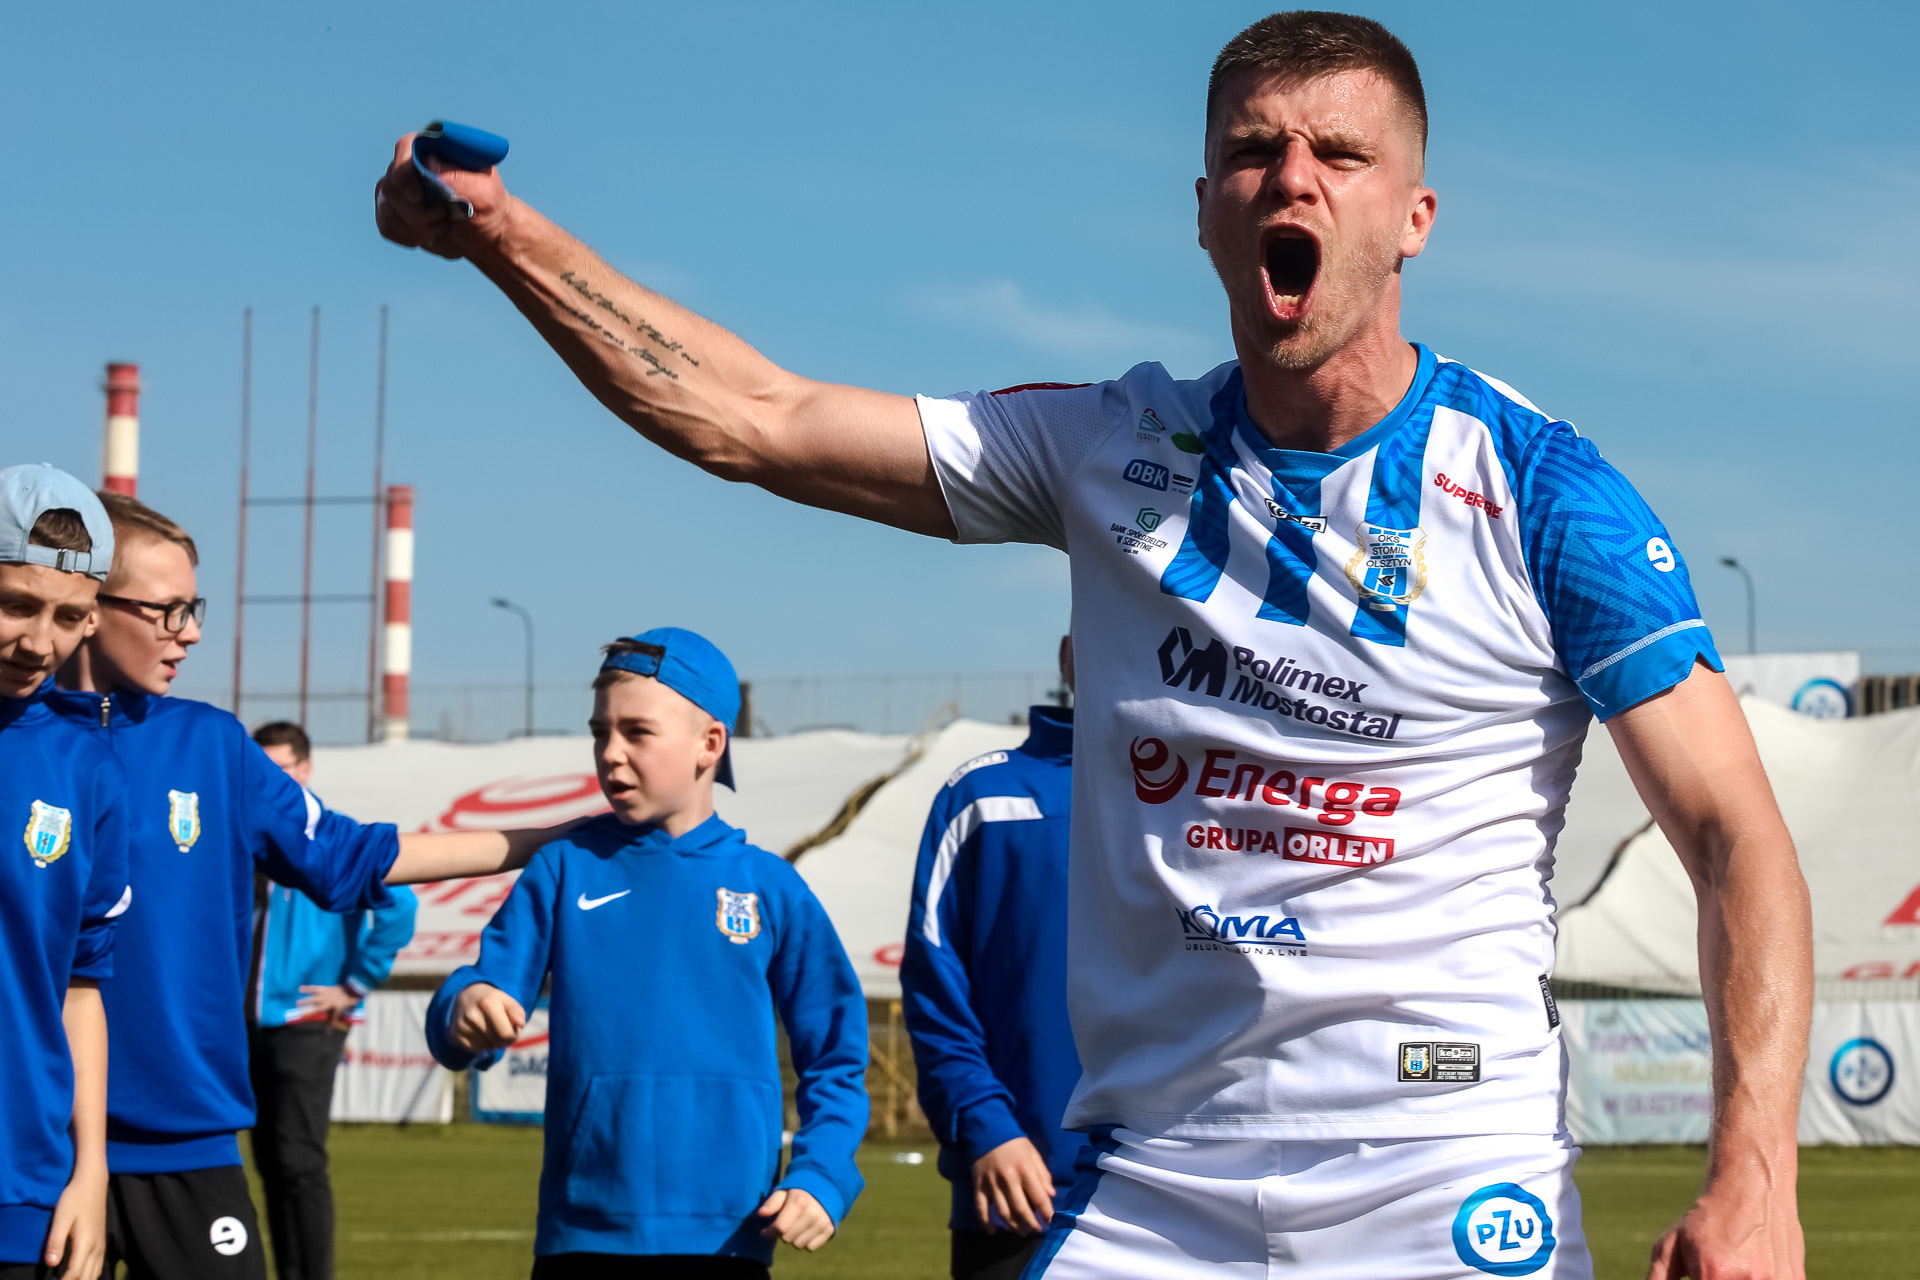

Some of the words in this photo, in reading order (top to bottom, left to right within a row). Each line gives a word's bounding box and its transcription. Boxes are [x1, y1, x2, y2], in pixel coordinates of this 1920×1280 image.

[1128, 462, 1166, 487] DBK
[1110, 522, 1128, 534] BANK
[1378, 534, 1400, 543] OKS
[1366, 558, 1412, 567] OLSZTYN
[1372, 546, 1406, 555] STOMIL
[1233, 645, 1369, 703] Polimex
[1229, 674, 1403, 739] Mostostal
[1195, 749, 1401, 826] Energa
[1186, 824, 1279, 855] GRUPA
[1288, 832, 1387, 864] ORLEN
[1175, 904, 1306, 941] KOMA
[1476, 1209, 1534, 1251] PZU
